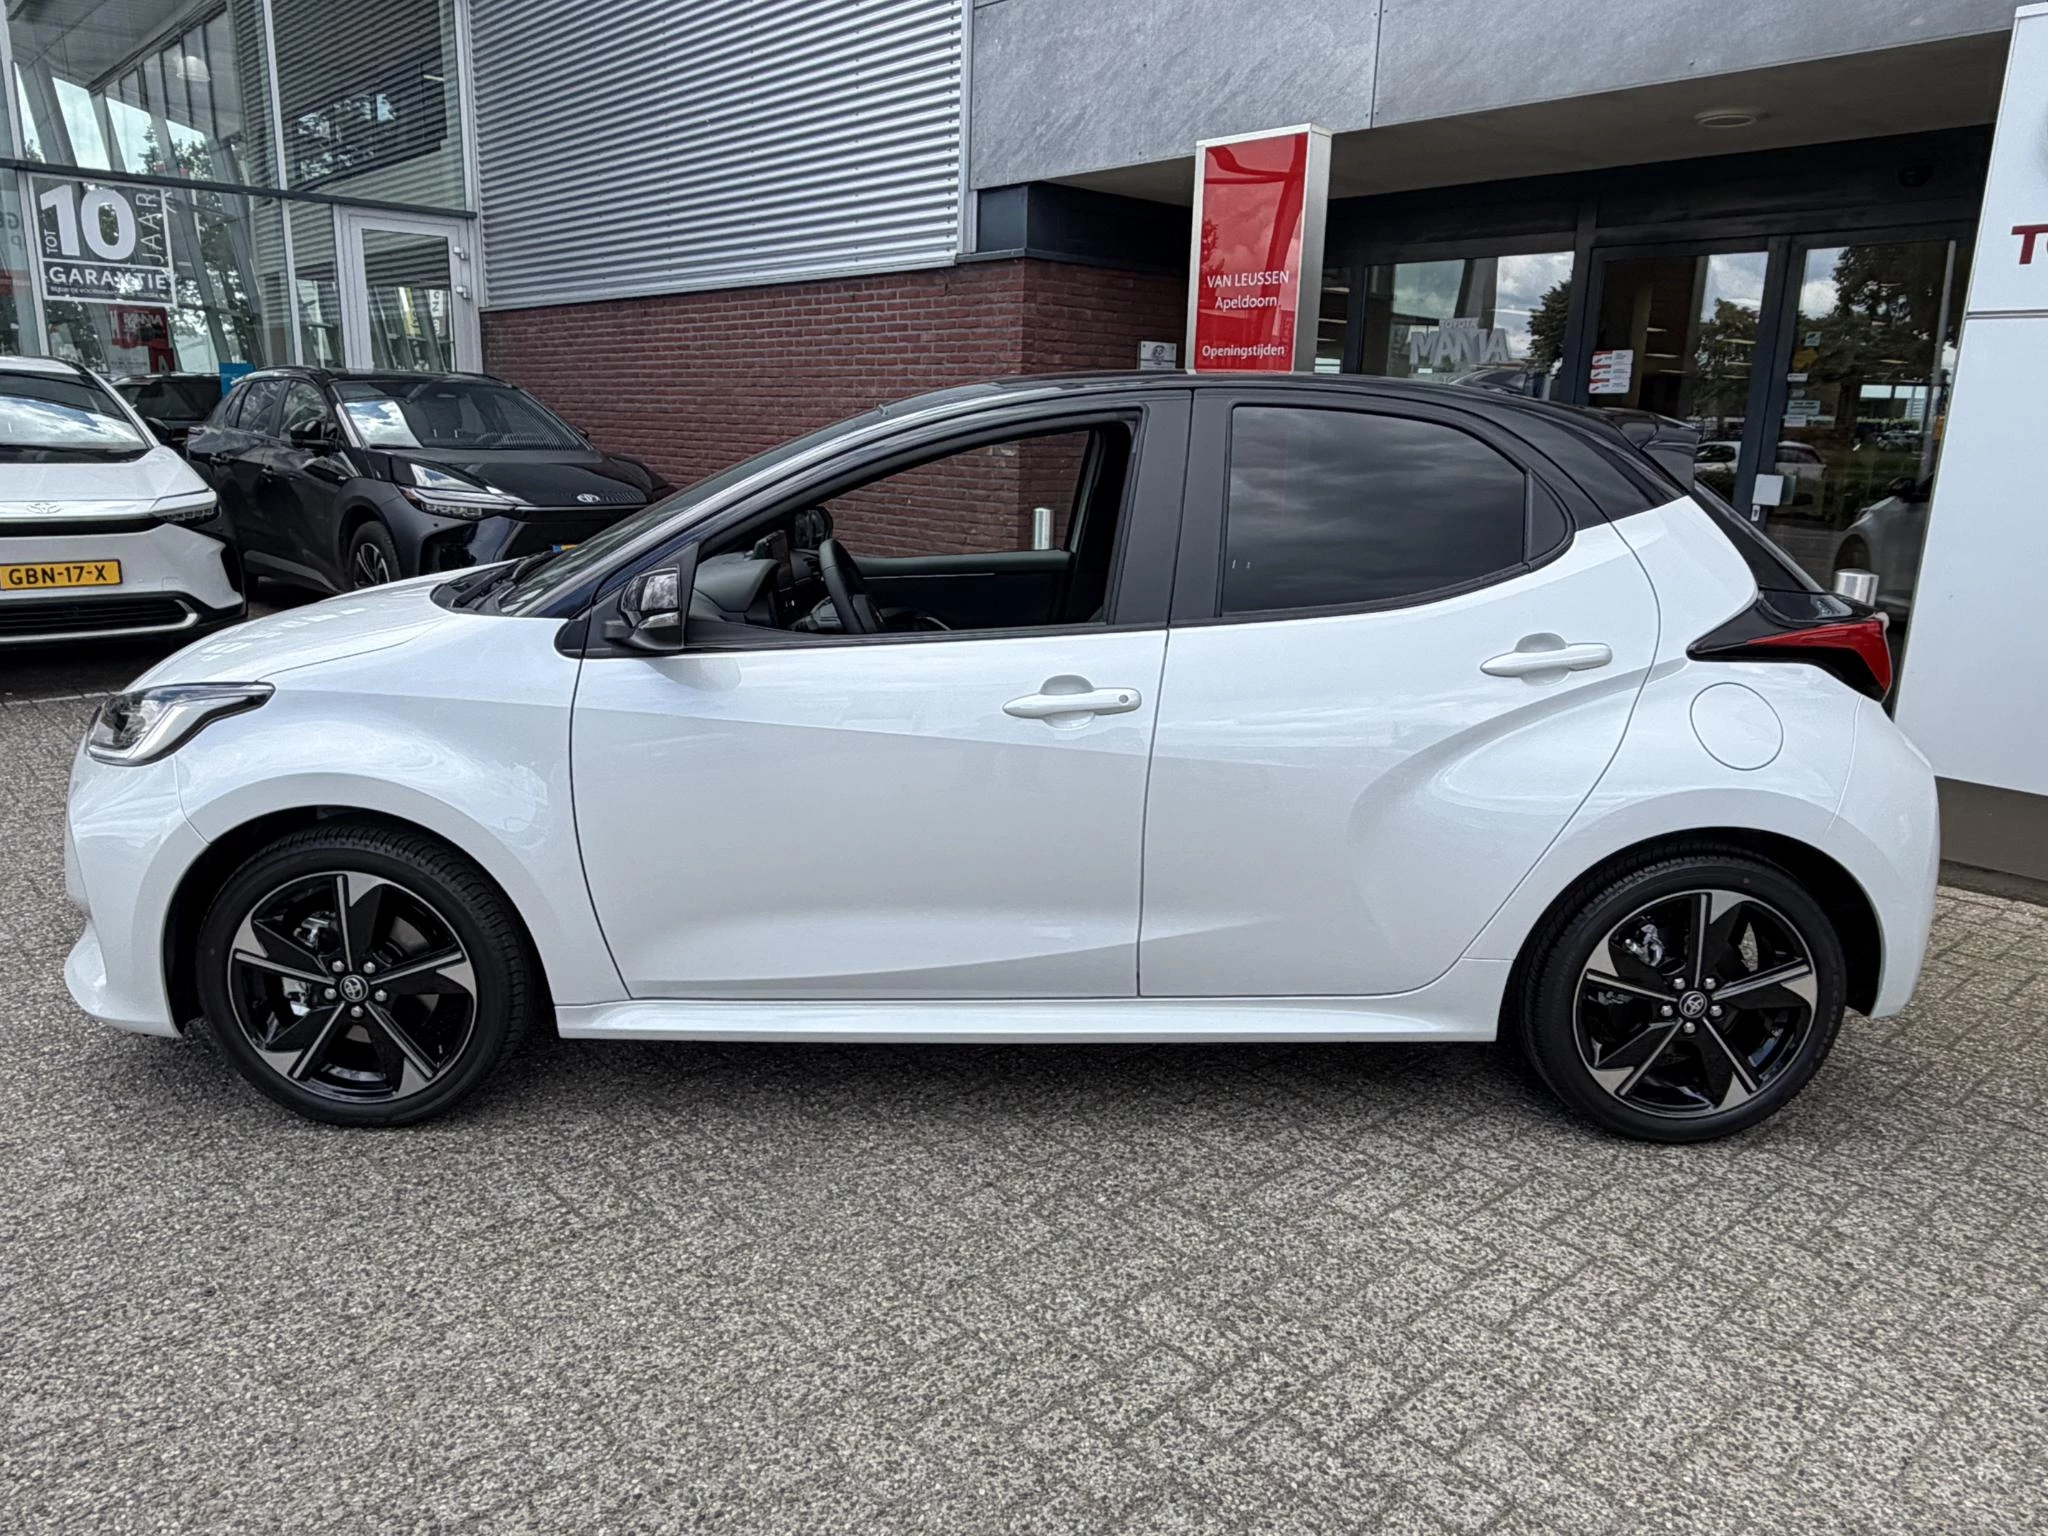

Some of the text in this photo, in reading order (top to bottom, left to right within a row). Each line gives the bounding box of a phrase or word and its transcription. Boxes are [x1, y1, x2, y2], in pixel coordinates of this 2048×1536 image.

[40, 184, 165, 264] TOT 10 JAAR
[2011, 223, 2048, 266] T
[49, 266, 168, 291] GARANTIE
[1207, 270, 1290, 289] VAN LEUSSEN
[1214, 293, 1278, 313] Apeldoorn
[1202, 343, 1285, 360] Openingstijden
[1409, 327, 1509, 370] MANIA
[8, 564, 108, 586] GBN-17-X
